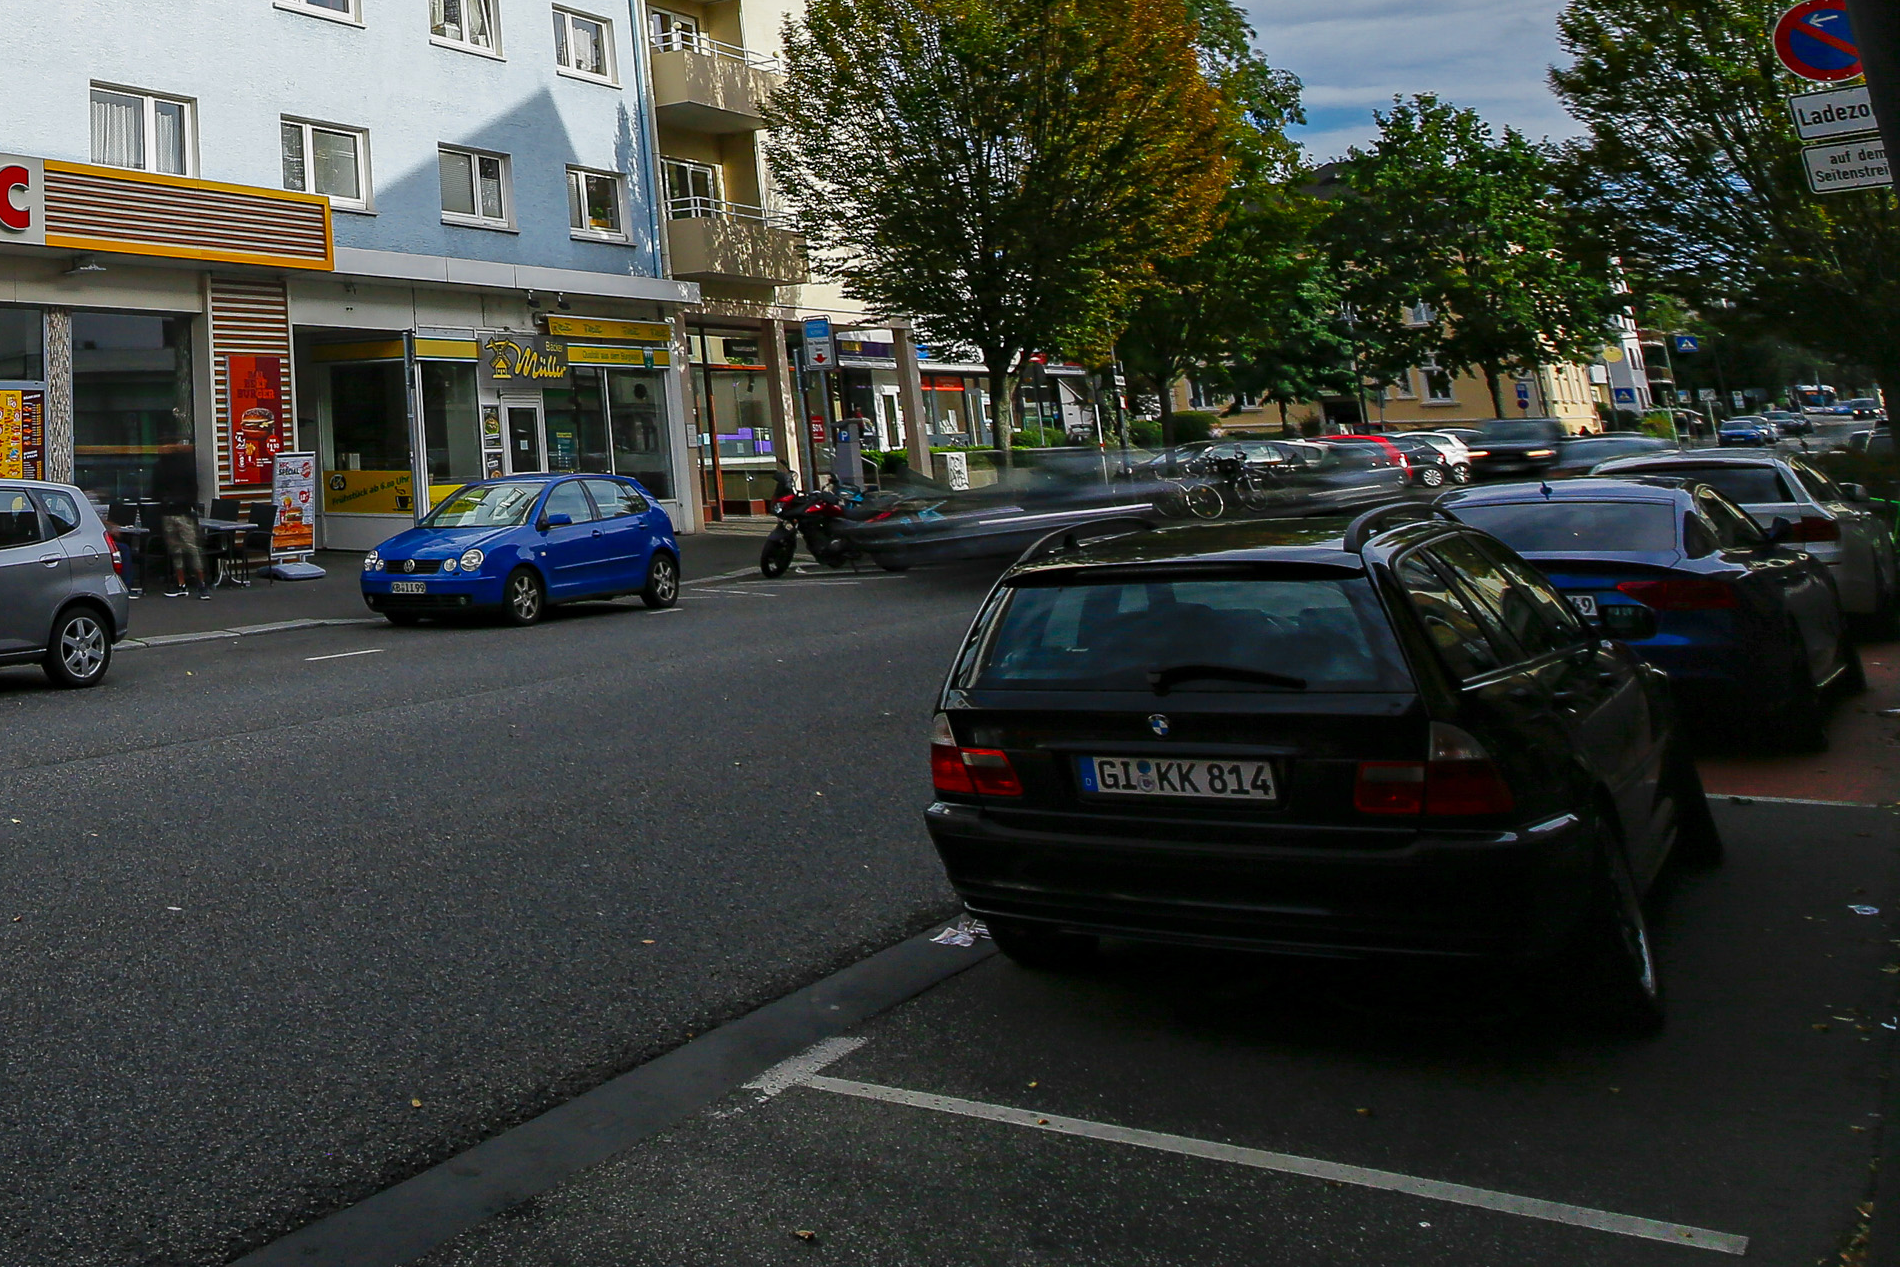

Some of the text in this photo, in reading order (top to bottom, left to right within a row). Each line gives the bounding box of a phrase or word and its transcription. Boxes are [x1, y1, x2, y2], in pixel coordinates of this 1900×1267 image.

[1798, 103, 1872, 126] Ladezo
[1829, 150, 1851, 165] auf
[1815, 162, 1889, 183] Seitenstrei
[841, 430, 849, 441] P
[396, 475, 409, 485] Uhr
[1098, 760, 1137, 790] GI
[1155, 762, 1200, 793] KK
[1207, 763, 1272, 796] 814
